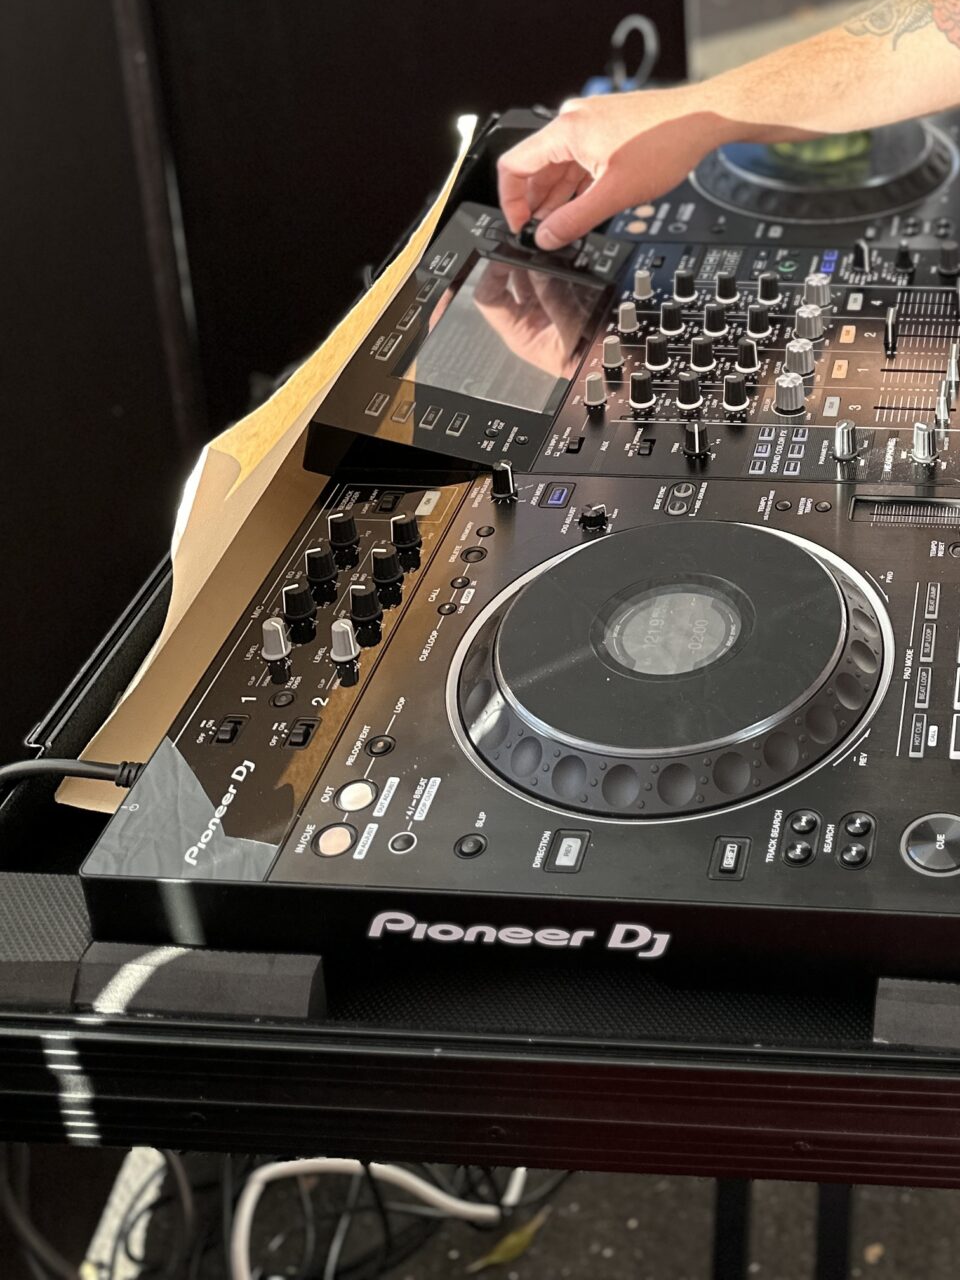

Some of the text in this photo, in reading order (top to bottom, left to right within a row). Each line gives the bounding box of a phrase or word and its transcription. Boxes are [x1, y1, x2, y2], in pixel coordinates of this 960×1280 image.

[600, 440, 610, 451] AUX
[770, 429, 788, 472] SOUND COLOR FX
[818, 440, 829, 464] PARAMETER
[884, 438, 896, 472] HEADPHONES
[531, 483, 545, 506] JOG MODE
[653, 486, 666, 510] BEAT SYNC
[758, 497, 767, 512] TEMPO
[797, 497, 806, 515] MASTER
[805, 498, 813, 513] TEMPO
[561, 507, 576, 534] JOG ADJUST
[460, 521, 474, 541] MEMORY
[449, 545, 462, 563] DELETE
[286, 571, 295, 579] EQ
[351, 573, 360, 581] EQ
[886, 571, 894, 583] FWD
[428, 588, 440, 602] CALL
[251, 605, 264, 619] MIC
[928, 597, 936, 612] BEAT
[244, 643, 259, 661] LEVEL
[313, 645, 327, 663] LEVEL
[419, 630, 439, 662] CUE/LOOP
[905, 649, 914, 667] MODE
[285, 676, 294, 689] TALK
[292, 676, 302, 689] OVER
[312, 697, 329, 706] 2
[394, 697, 406, 714] LOOP
[207, 720, 215, 728] ON
[279, 722, 287, 731] ON
[196, 732, 206, 744] OFF
[270, 735, 279, 746] OFF
[346, 725, 371, 766] RELOOP/EXIT
[859, 753, 868, 767] REV
[321, 785, 335, 803] OUT
[184, 784, 237, 865] Pioneer
[475, 811, 486, 828] SLIP
[294, 824, 316, 853] IN/CUE
[766, 809, 783, 863] TRACK SEARCH
[823, 824, 835, 853] SEARCH
[936, 834, 945, 850] CUE
[532, 830, 551, 868] DIRECTION
[563, 843, 573, 857] REV
[368, 911, 670, 957] Pioneer DJ
